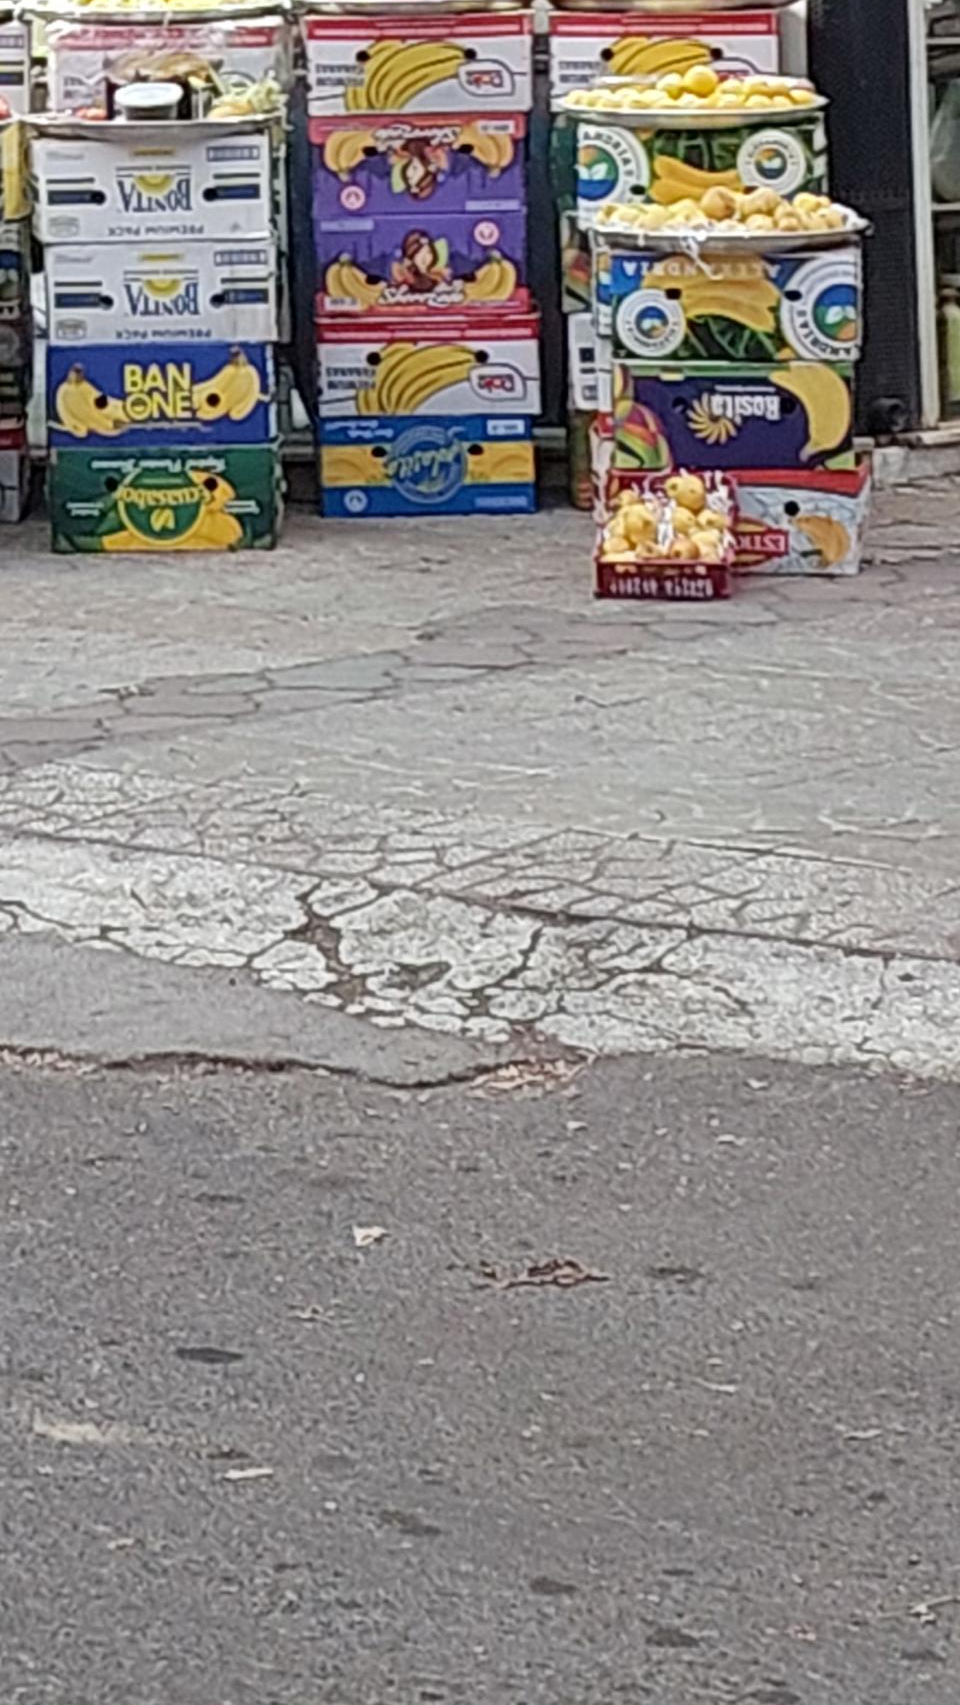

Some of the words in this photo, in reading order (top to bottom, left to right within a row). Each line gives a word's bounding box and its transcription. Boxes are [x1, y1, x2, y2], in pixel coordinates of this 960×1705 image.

[117, 178, 193, 213] BONITA
[623, 261, 782, 278] ALEXNDRIA
[124, 282, 200, 316] BONITA
[124, 362, 191, 393] BAN
[126, 392, 193, 420] ONE
